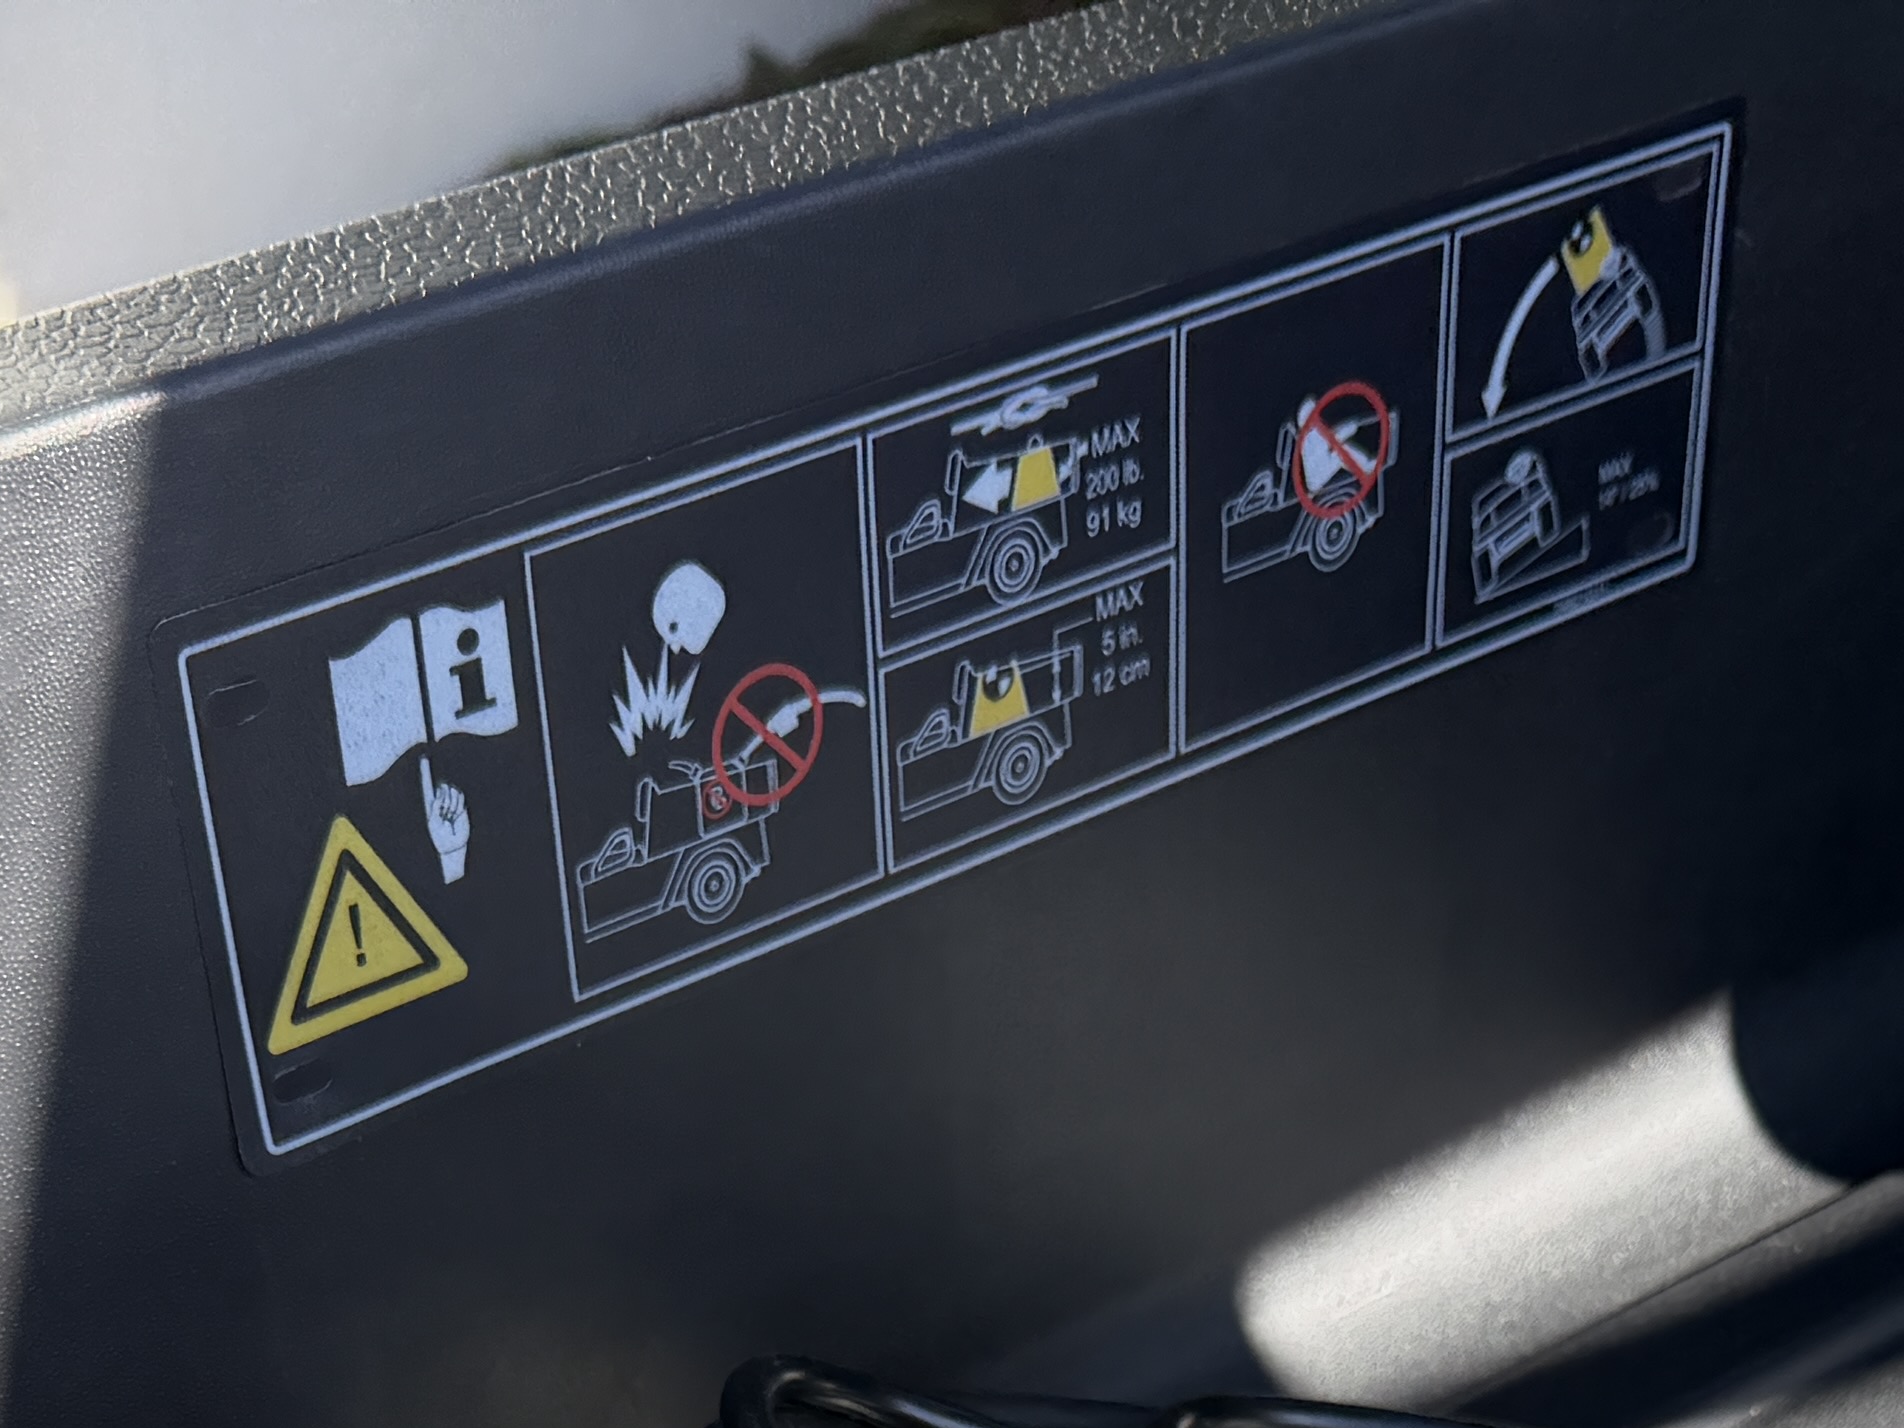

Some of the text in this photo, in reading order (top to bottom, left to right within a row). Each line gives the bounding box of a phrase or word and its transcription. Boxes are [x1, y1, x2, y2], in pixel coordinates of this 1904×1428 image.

[1091, 415, 1141, 458] MAX
[1085, 463, 1120, 500] 200
[1086, 498, 1142, 537] 91 kg
[1096, 580, 1144, 622] MAX
[1102, 629, 1116, 657] 5
[1092, 655, 1151, 697] 12 cm
